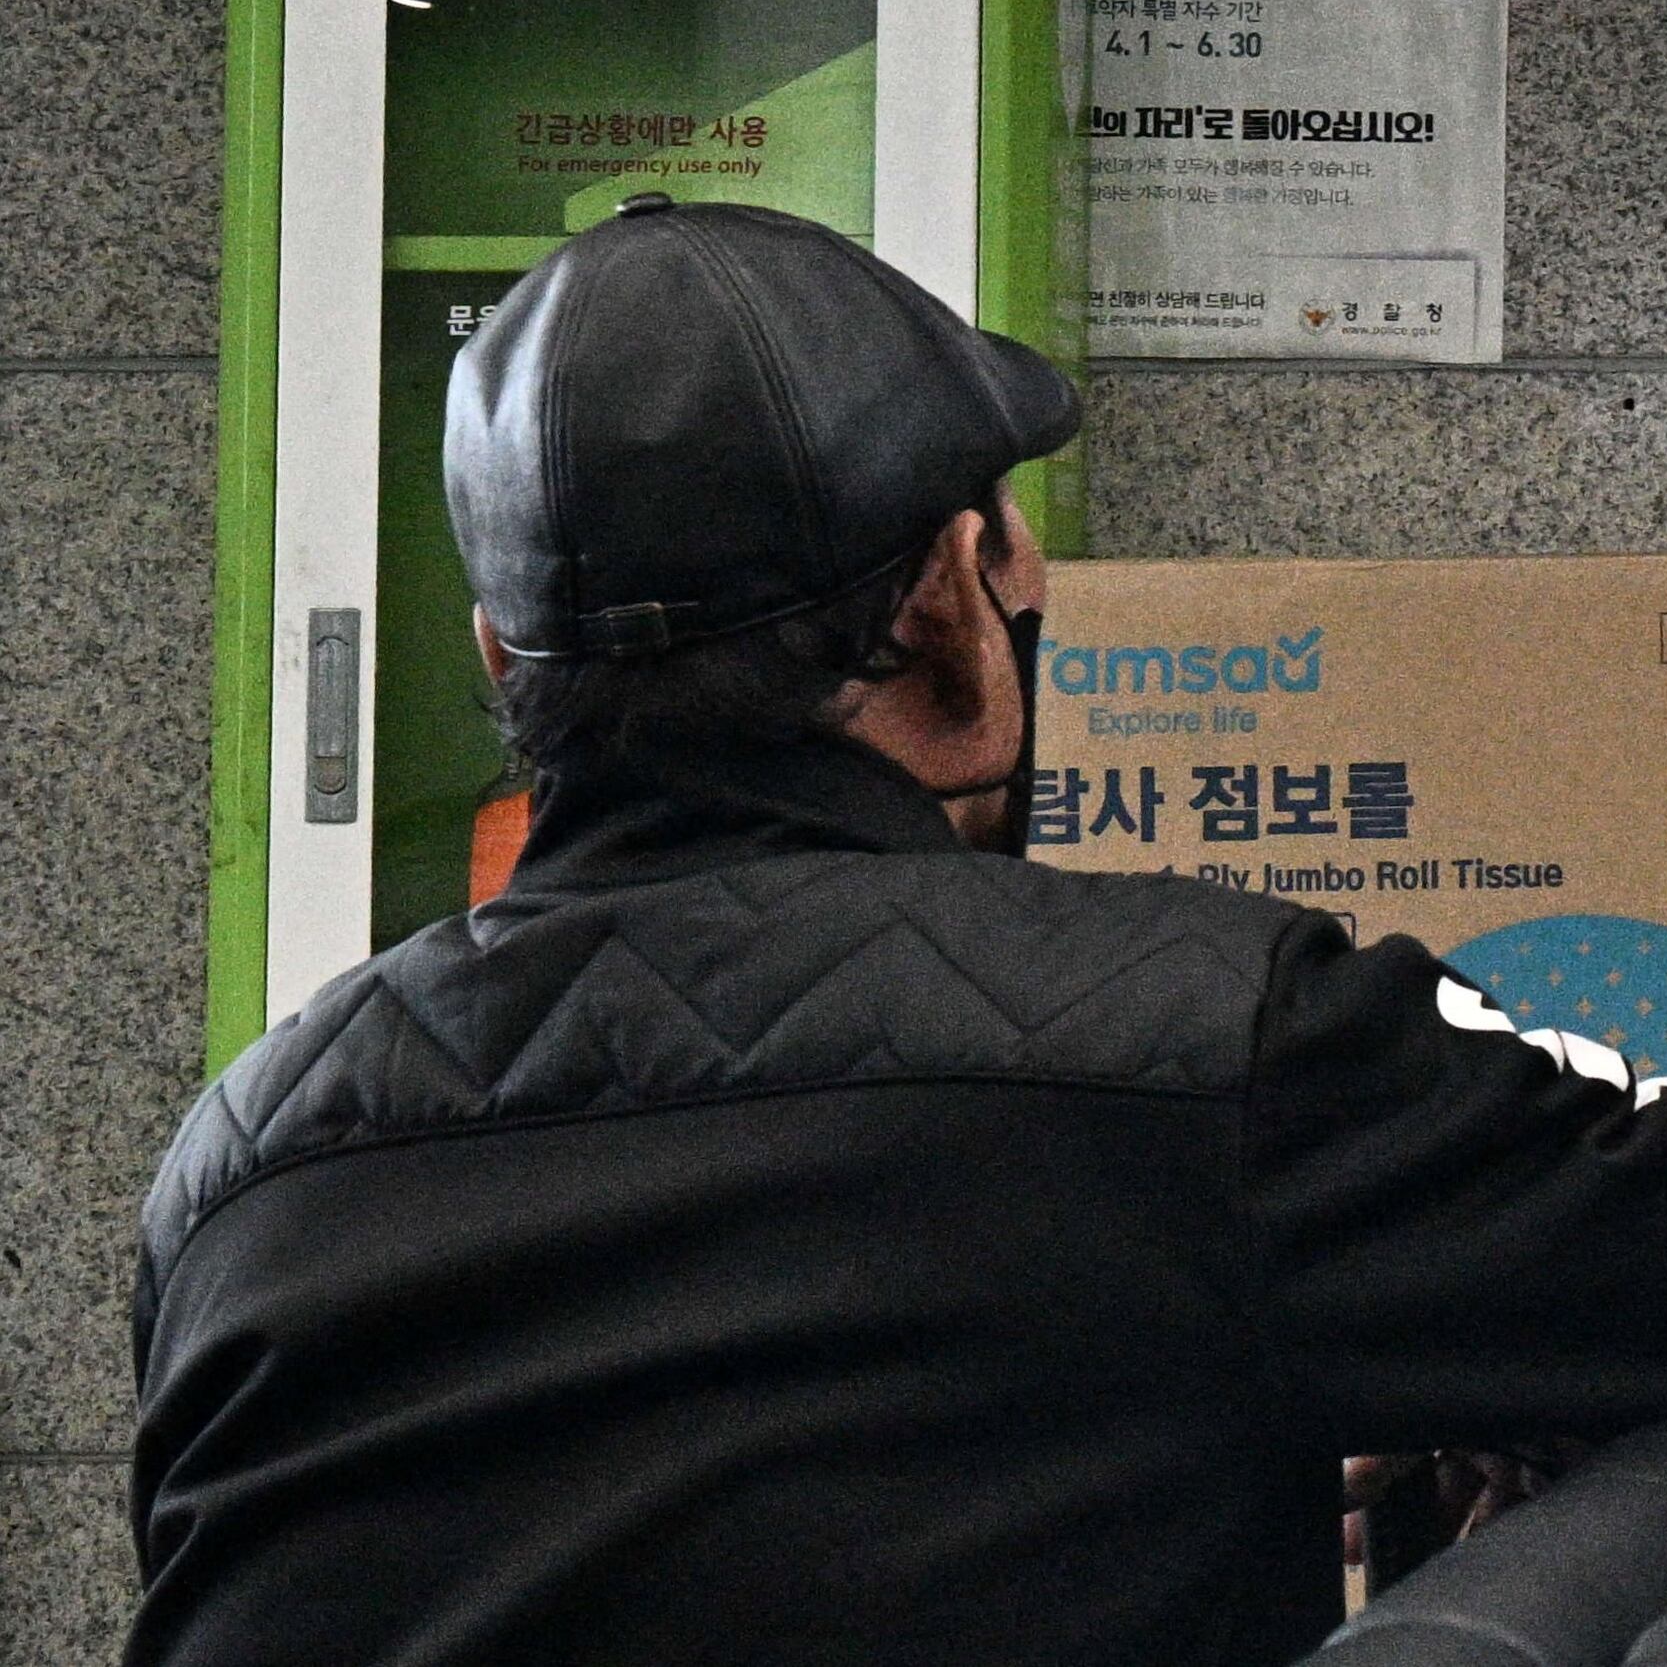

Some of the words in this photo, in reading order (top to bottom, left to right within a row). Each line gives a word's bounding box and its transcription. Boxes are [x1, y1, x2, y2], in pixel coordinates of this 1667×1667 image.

[1225, 0, 1265, 24] 기간
[514, 112, 698, 148] 긴급상황에만
[709, 114, 769, 149] 사용
[1240, 106, 1436, 143] 돌아오십시오!
[516, 154, 553, 176] For
[556, 154, 673, 180] emergency
[676, 156, 713, 177] use
[716, 154, 764, 181] only
[1203, 292, 1266, 310] 드립니다
[1087, 704, 1202, 736] Explore
[1212, 704, 1260, 735] life
[1027, 764, 1168, 846] 탐사
[1186, 758, 1417, 844] 점보롤
[1264, 860, 1368, 896] Jumbo
[1376, 859, 1440, 891] Roll
[1450, 857, 1564, 890] Tissue
